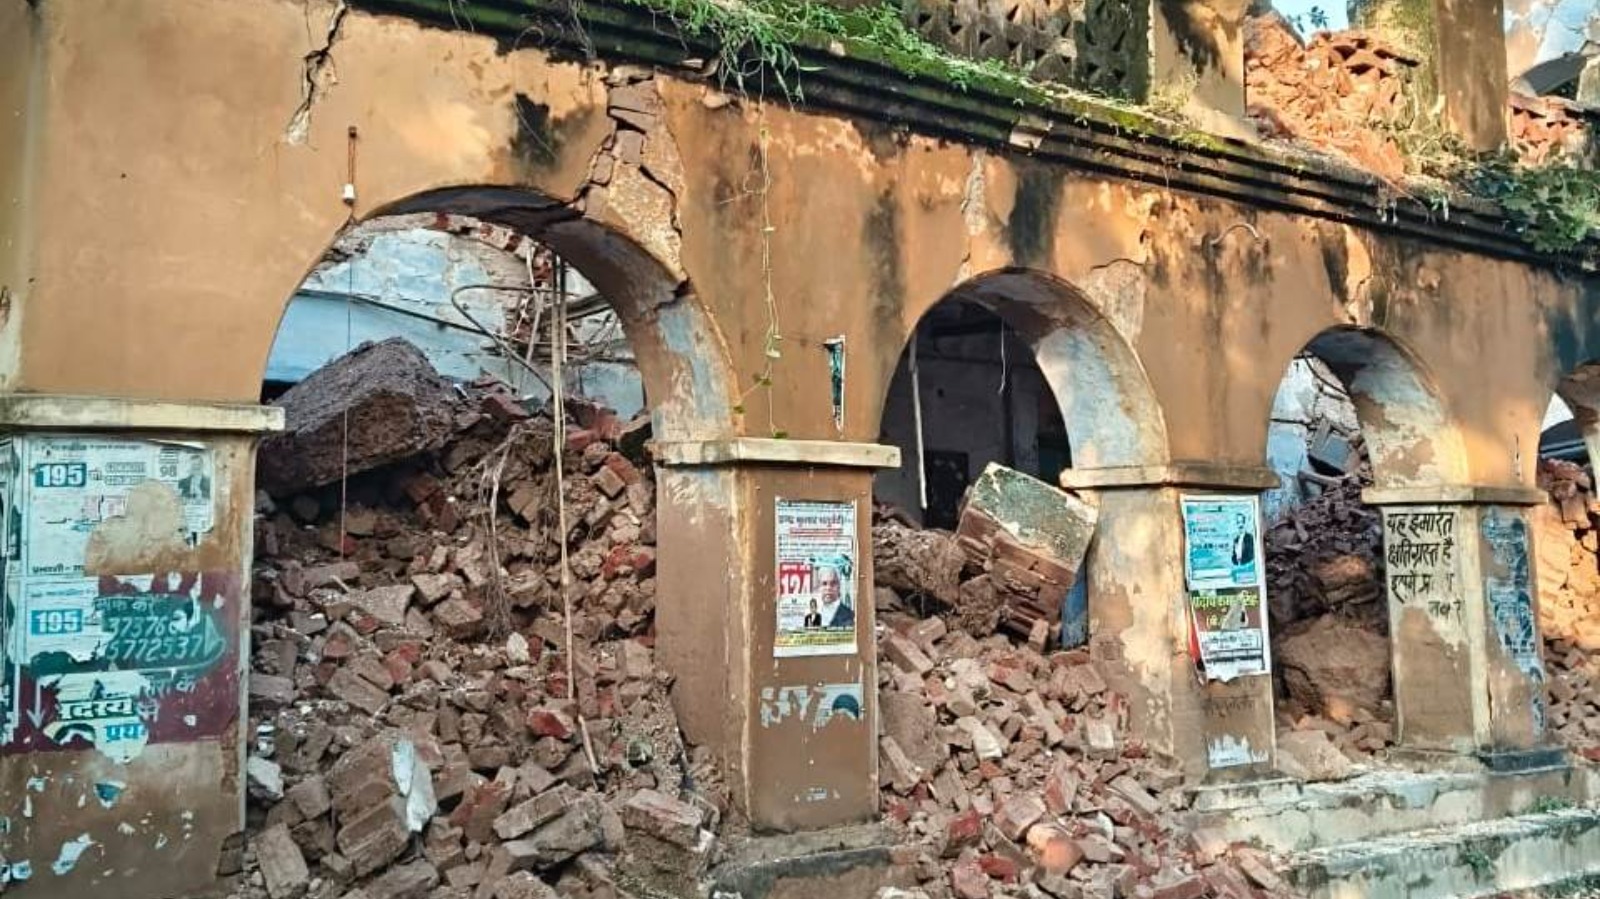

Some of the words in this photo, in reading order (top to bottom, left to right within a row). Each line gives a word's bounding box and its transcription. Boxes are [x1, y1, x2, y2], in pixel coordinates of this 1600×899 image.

[39, 463, 85, 487] 195
[1387, 512, 1408, 538] यह
[1409, 511, 1455, 538] इमारत
[1388, 538, 1440, 569] क्षतिग्रस्त
[1442, 537, 1454, 566] है
[34, 611, 81, 633] 195
